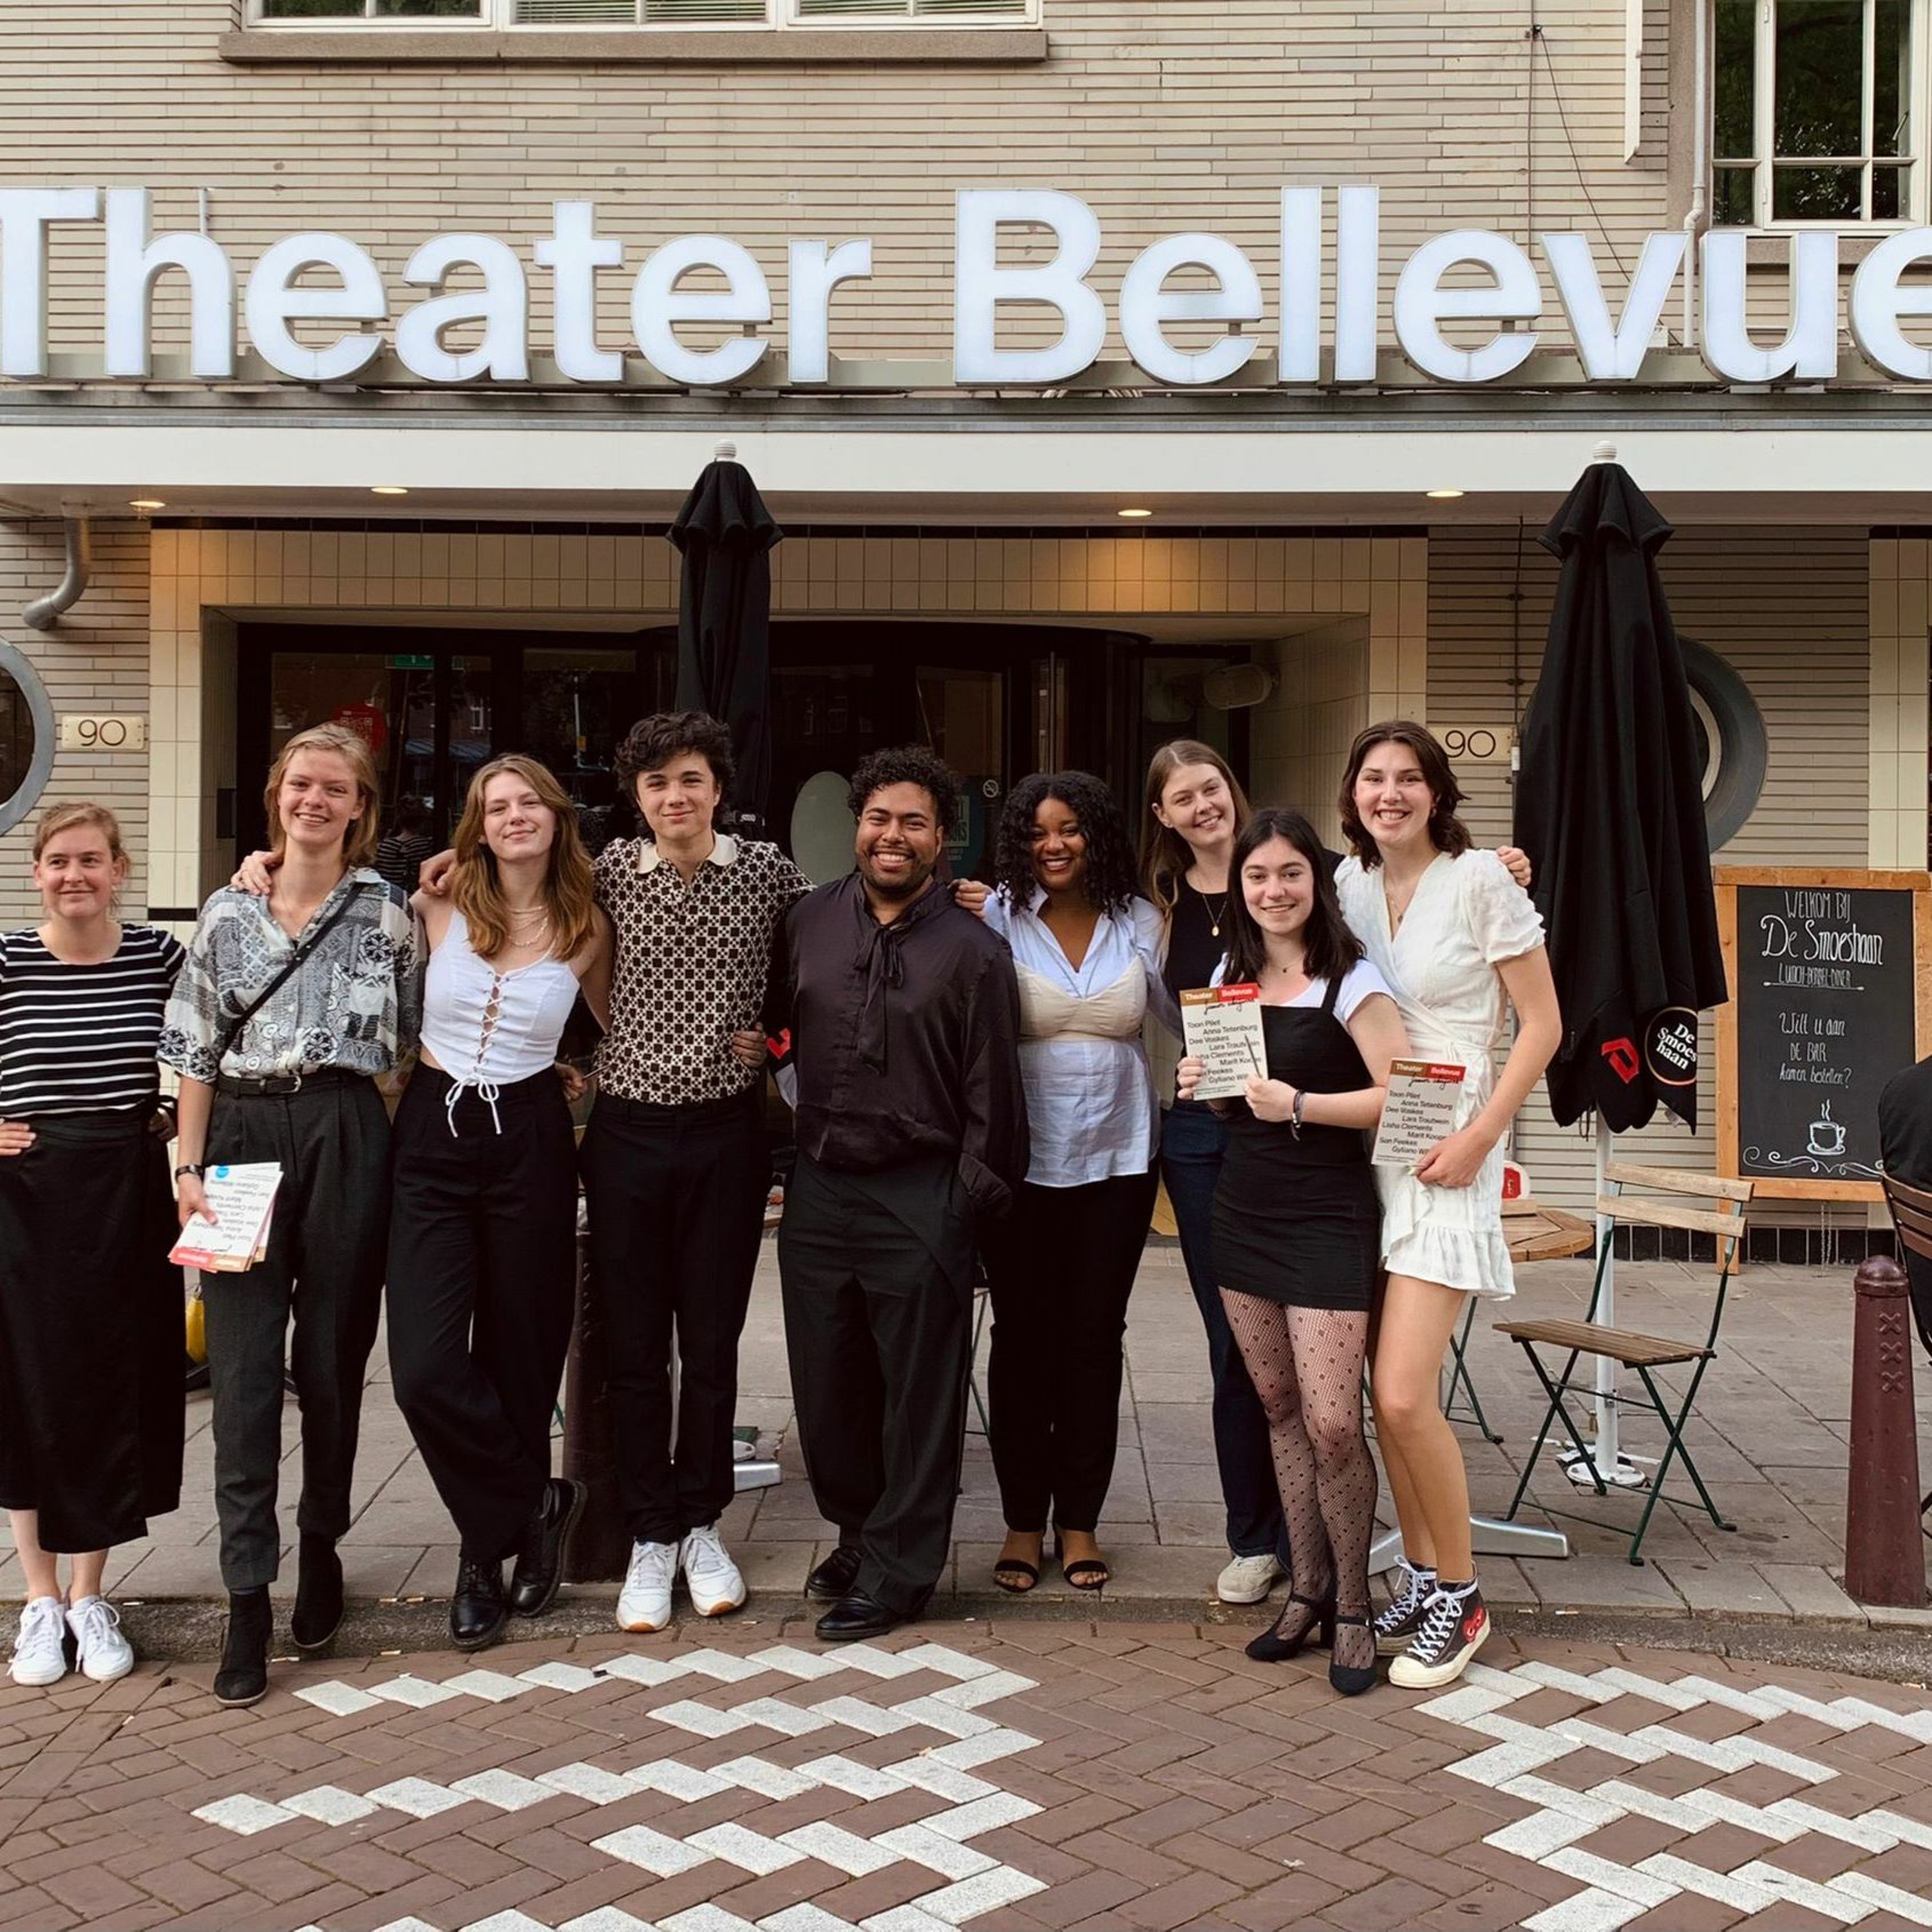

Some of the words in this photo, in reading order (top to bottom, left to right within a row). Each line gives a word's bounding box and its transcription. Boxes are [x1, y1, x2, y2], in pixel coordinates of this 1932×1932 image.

[0, 187, 873, 384] Theater
[954, 184, 1932, 384] Bellevue
[78, 719, 127, 746] 90
[1444, 730, 1496, 758] 90
[1785, 891, 1831, 919] WELKOM
[1836, 892, 1850, 923] BIJ
[1761, 914, 1799, 958] De
[1804, 920, 1884, 965] Smoeshaan
[1673, 1023, 1696, 1045] De
[1814, 1018, 1823, 1035] u
[1826, 1019, 1846, 1036] aan
[1656, 1041, 1690, 1071] haan
[1657, 1027, 1696, 1063] Smoes
[1790, 1042, 1802, 1061] DE
[1807, 1042, 1827, 1062] BAR
